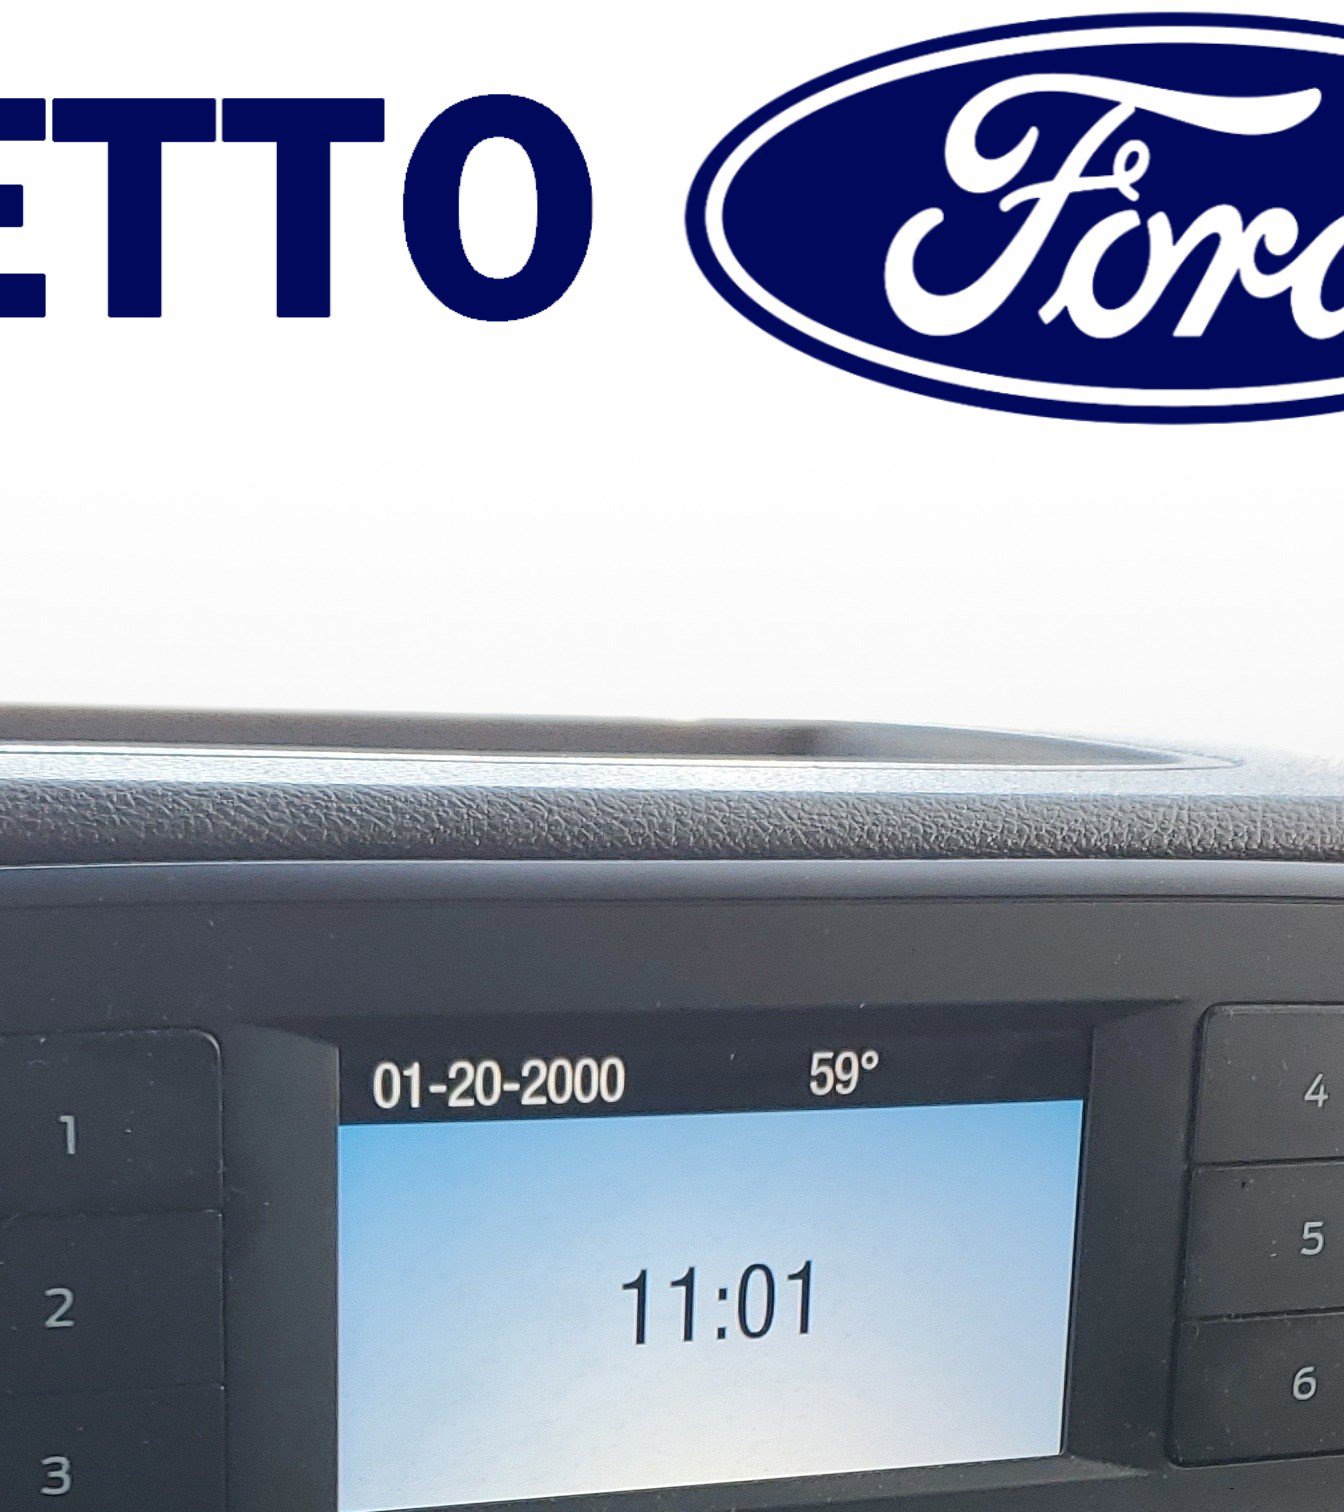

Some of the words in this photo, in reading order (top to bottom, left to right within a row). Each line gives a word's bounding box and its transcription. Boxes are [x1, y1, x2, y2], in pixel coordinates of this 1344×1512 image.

[372, 1056, 626, 1110] 01-20-2000
[809, 1051, 878, 1095] 59°
[1303, 1074, 1329, 1108] 4
[58, 1114, 78, 1156] 1
[1299, 1221, 1325, 1256] 5
[43, 1287, 75, 1329] 2
[620, 1259, 816, 1346] 11:01
[1291, 1366, 1318, 1401] 6
[40, 1455, 73, 1496] 3
